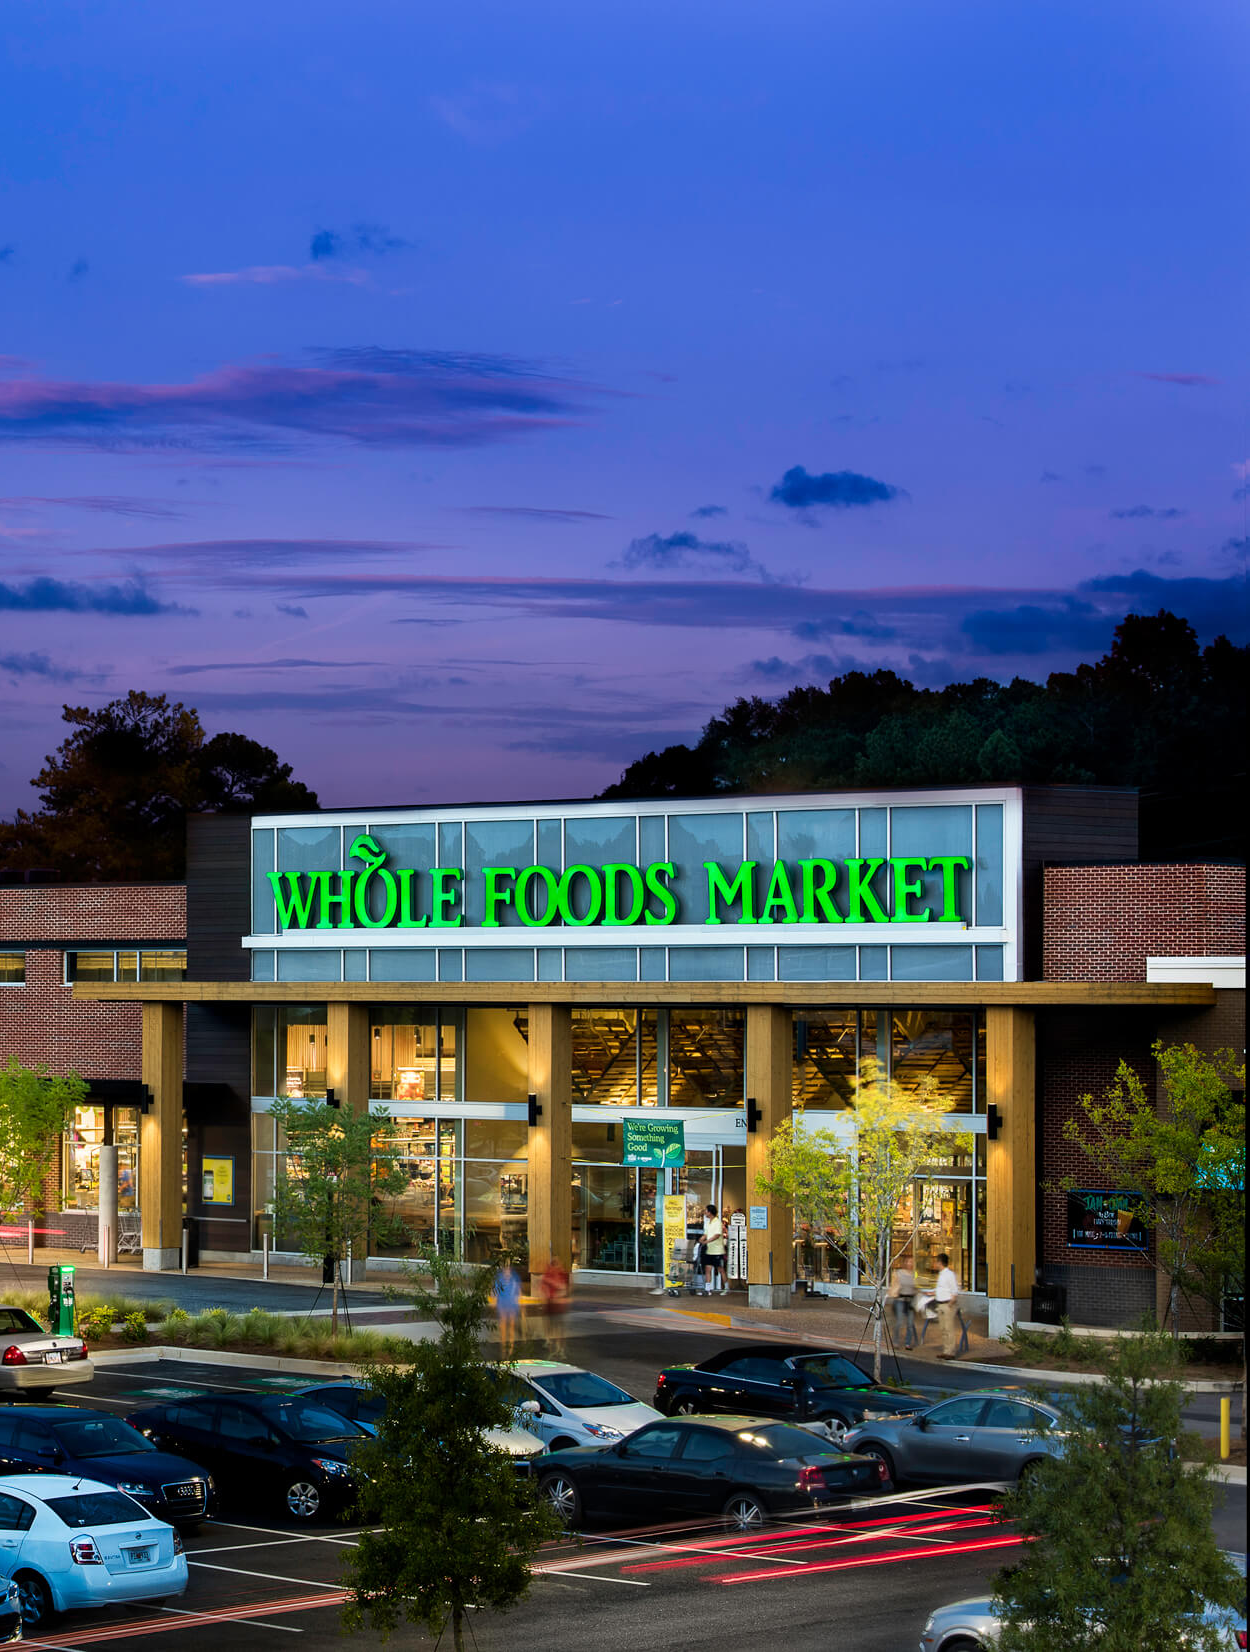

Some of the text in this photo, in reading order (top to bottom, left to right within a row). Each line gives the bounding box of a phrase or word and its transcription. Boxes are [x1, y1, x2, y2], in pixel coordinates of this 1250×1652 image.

[266, 834, 971, 930] WHOLE FOODS MARKET
[627, 1122, 679, 1135] We're Growing
[627, 1132, 665, 1145] Something
[627, 1143, 648, 1152] Good
